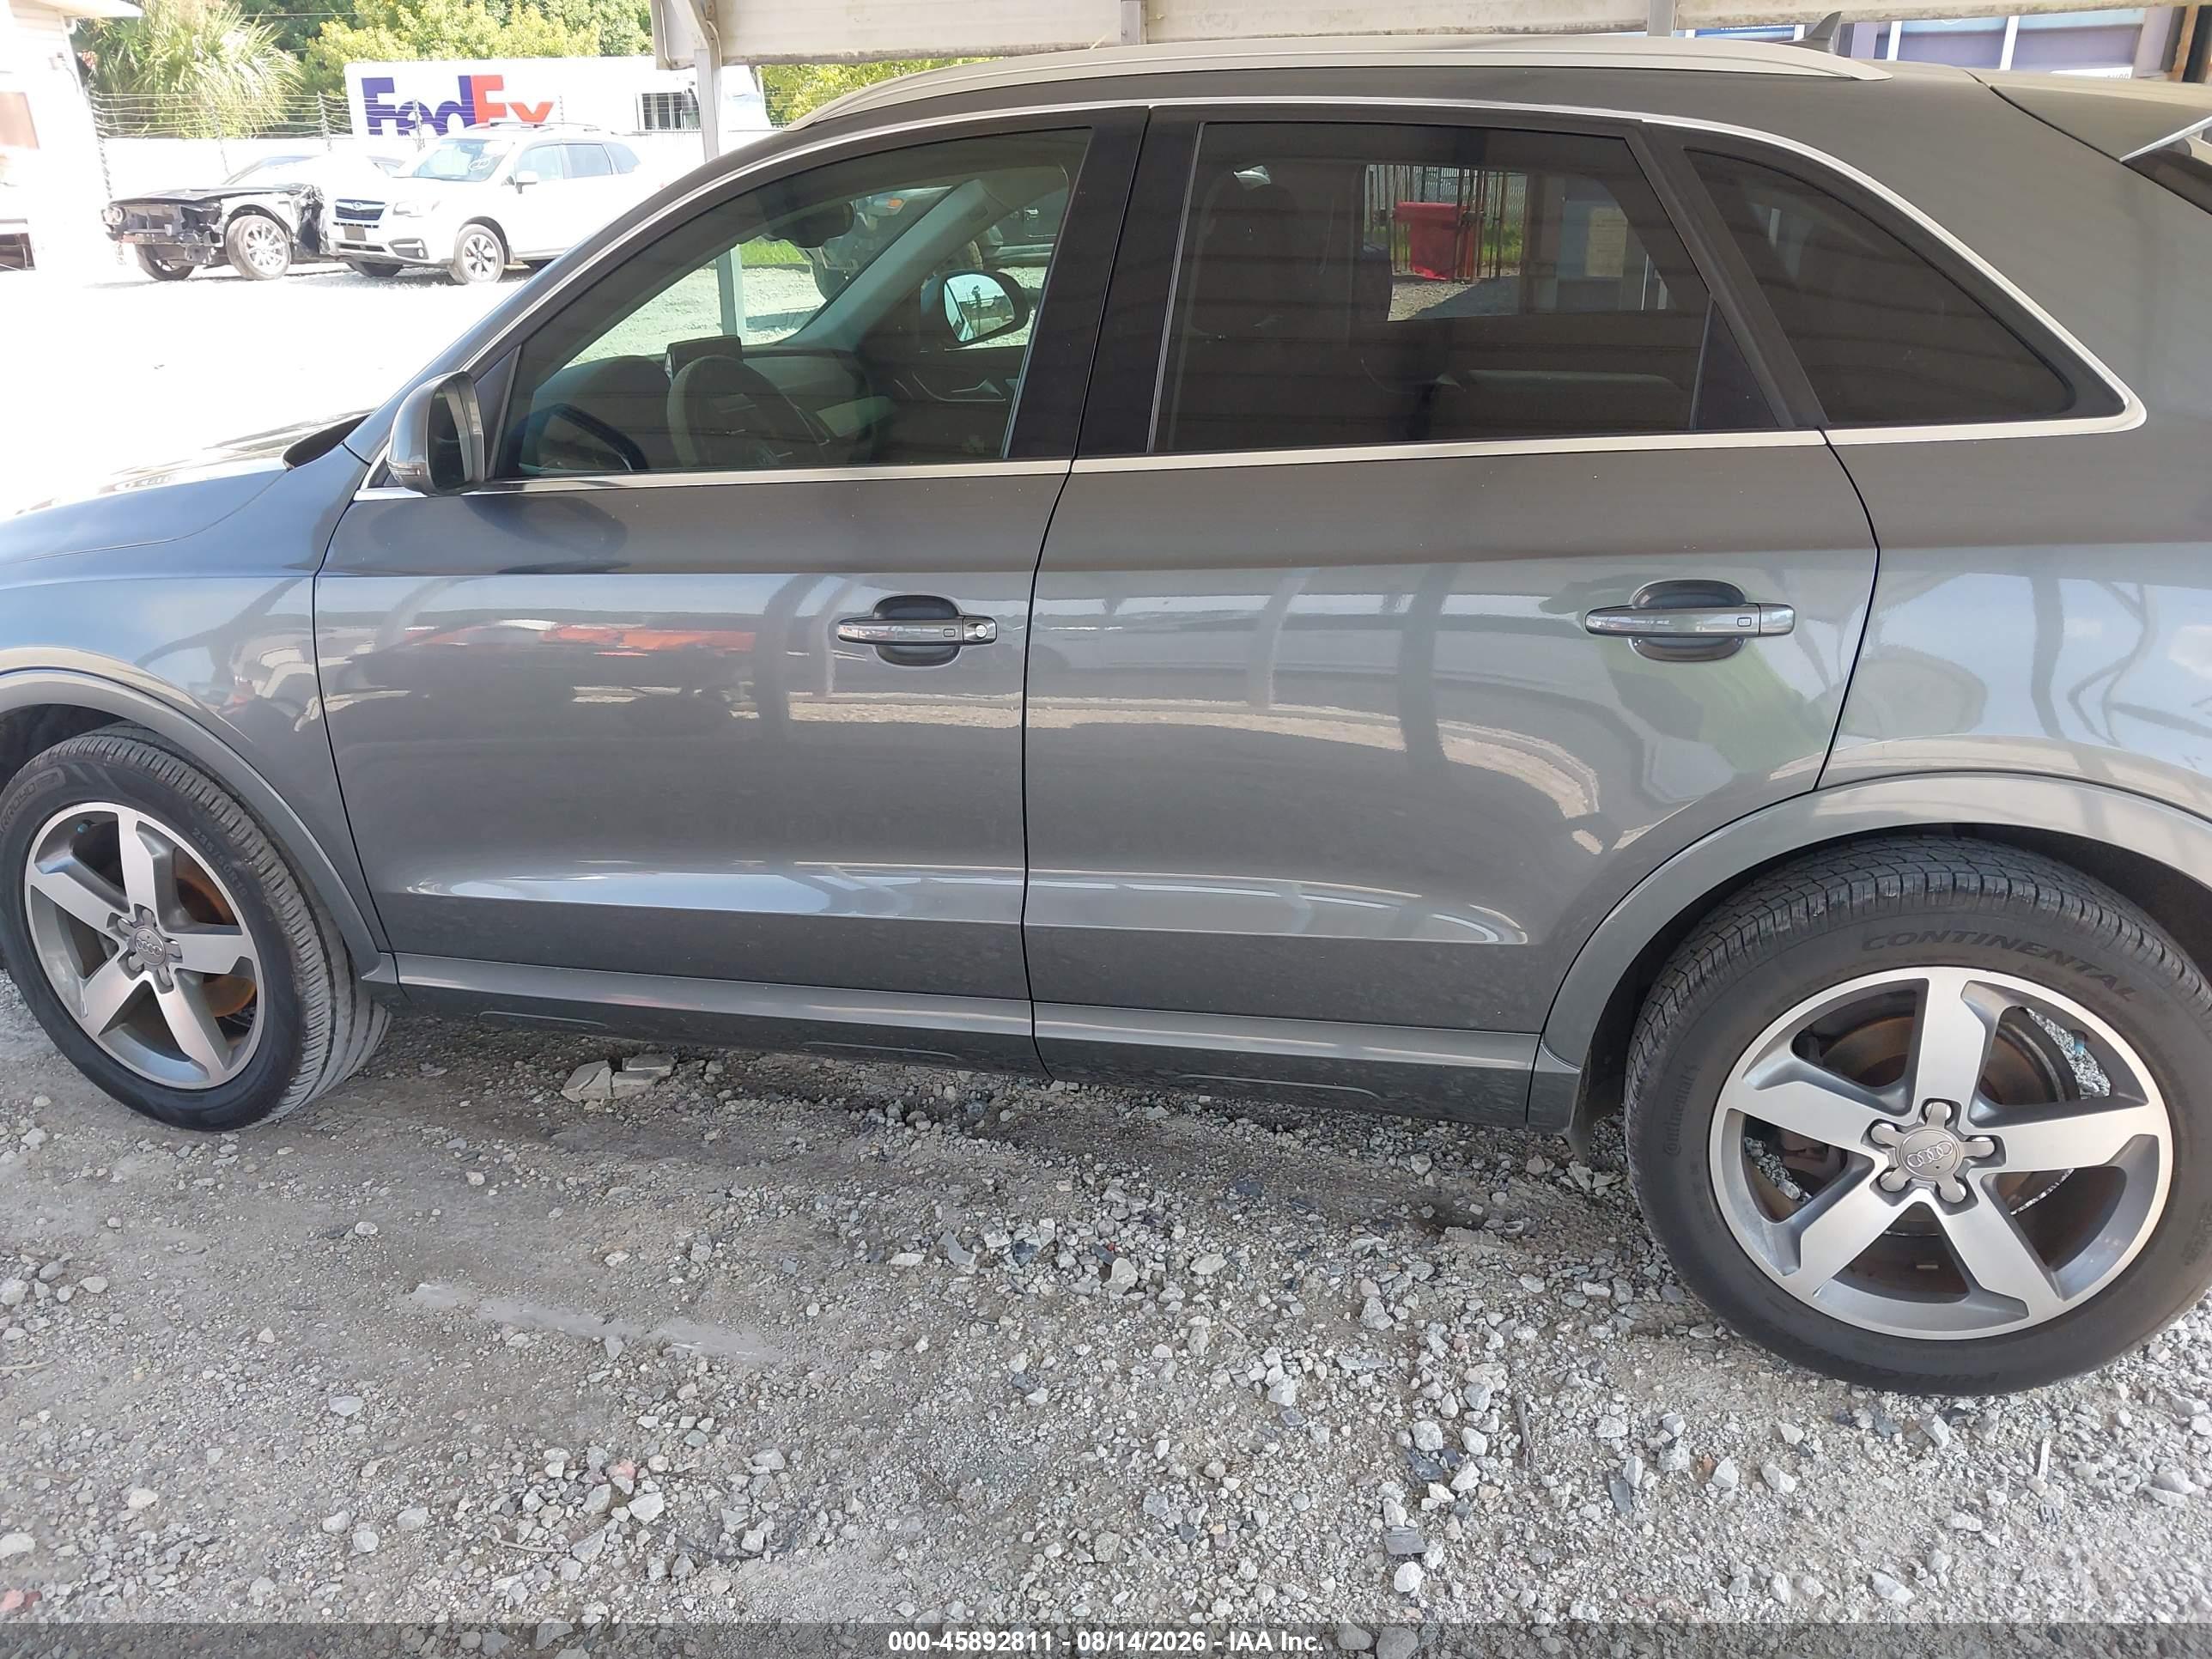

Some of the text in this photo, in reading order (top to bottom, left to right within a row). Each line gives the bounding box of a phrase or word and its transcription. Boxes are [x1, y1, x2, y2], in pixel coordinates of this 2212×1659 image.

[362, 75, 554, 136] FedEx
[0, 782, 36, 839] RROYO
[1862, 930, 2136, 1002] CONTINENTAL
